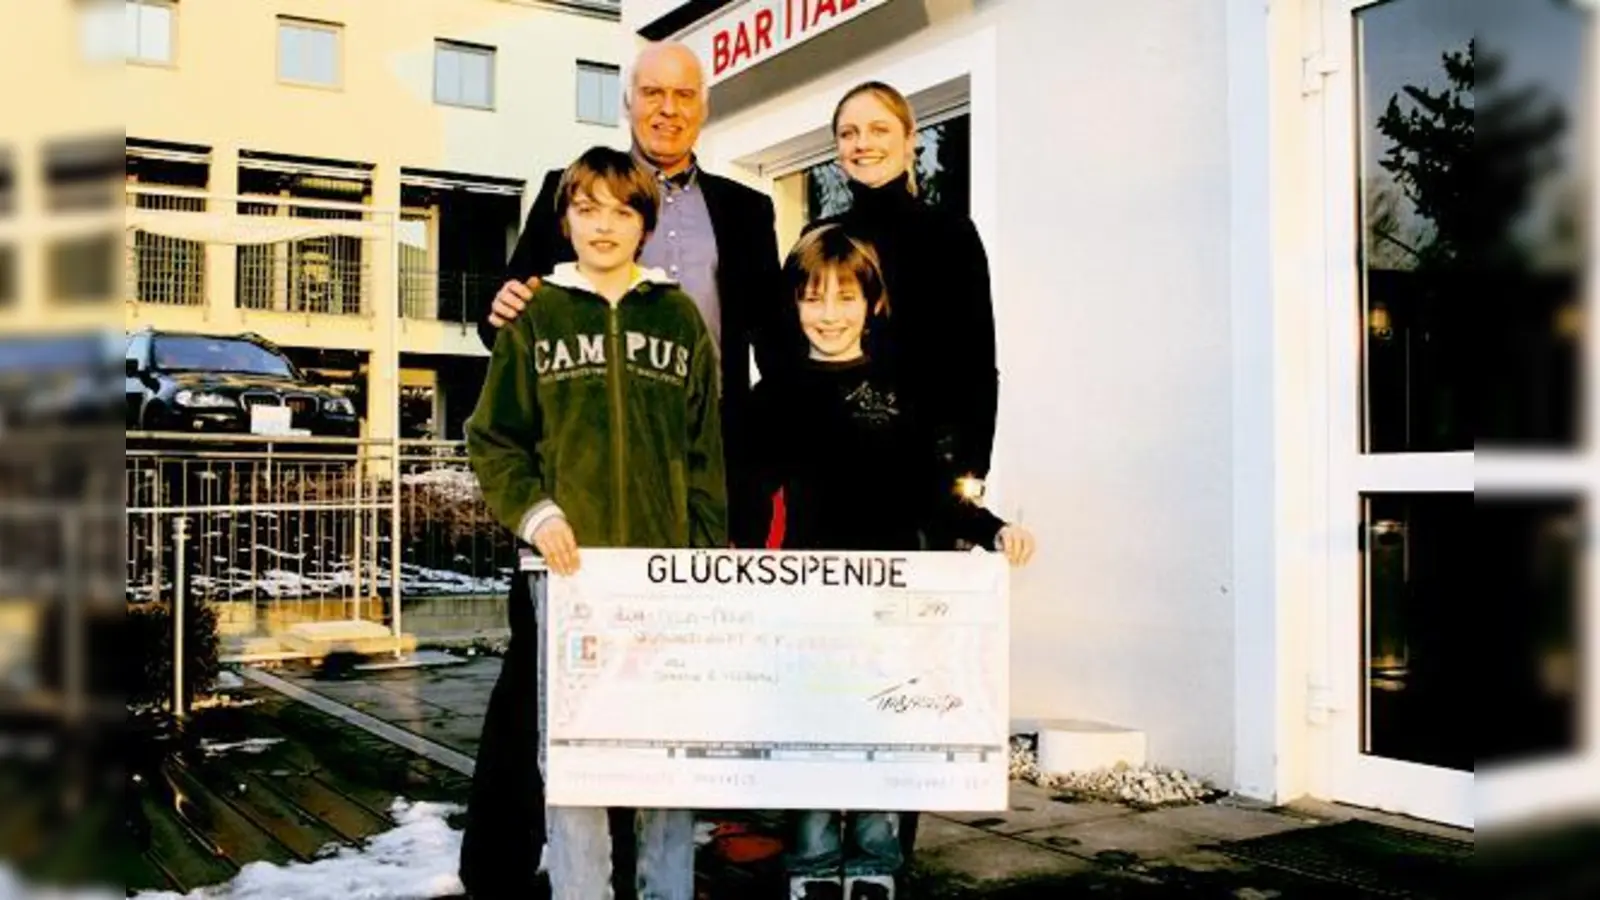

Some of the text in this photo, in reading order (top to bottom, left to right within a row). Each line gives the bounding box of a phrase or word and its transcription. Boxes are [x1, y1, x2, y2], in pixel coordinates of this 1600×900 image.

[712, 0, 865, 75] BAR ITA
[534, 330, 689, 377] CAMPUS
[647, 551, 907, 587] GLÜCKSSPENDE
